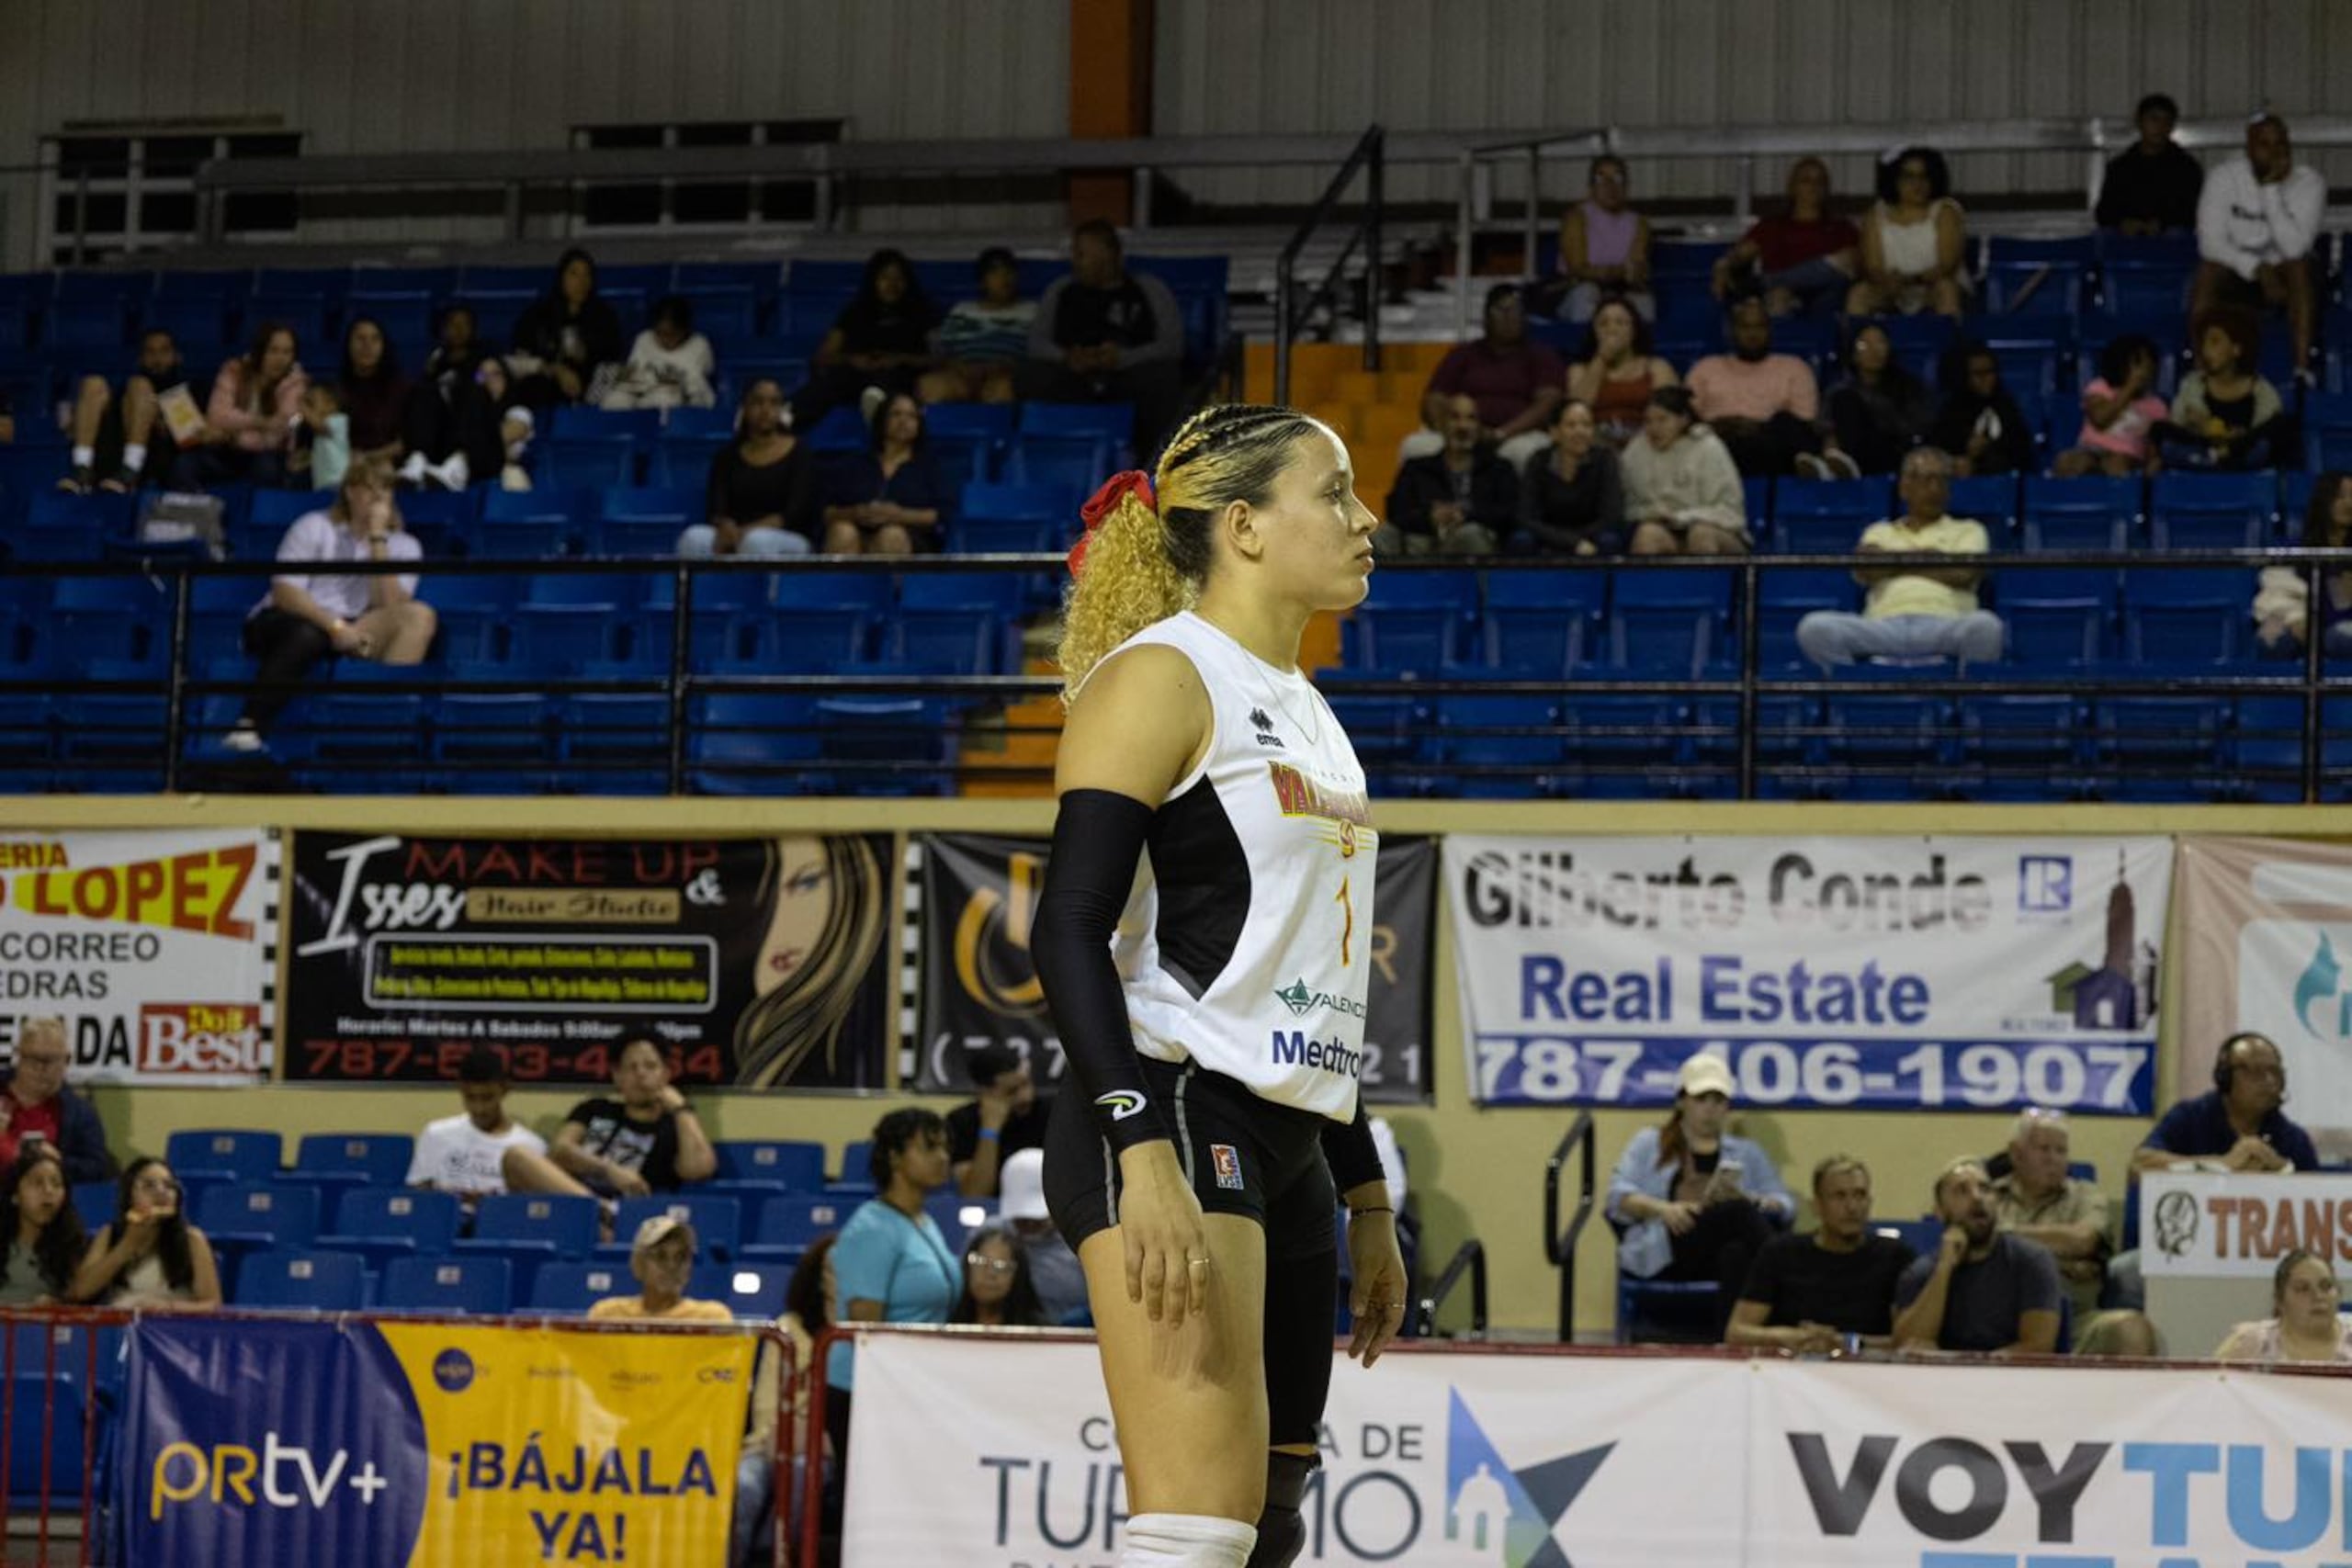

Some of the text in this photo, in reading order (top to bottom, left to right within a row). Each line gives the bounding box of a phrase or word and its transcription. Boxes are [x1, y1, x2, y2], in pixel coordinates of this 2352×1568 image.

[404, 842, 605, 883] MAKE
[633, 841, 720, 883] UP
[34, 842, 257, 943] LOPEZ
[1335, 874, 1352, 968] 1
[1, 931, 160, 963] CORREO
[0, 969, 108, 1000] DRAS
[1521, 954, 1929, 1026] Real Estate
[144, 1014, 259, 1071] Best
[1361, 1424, 1423, 1461] DE
[529, 1510, 627, 1561] YA!
